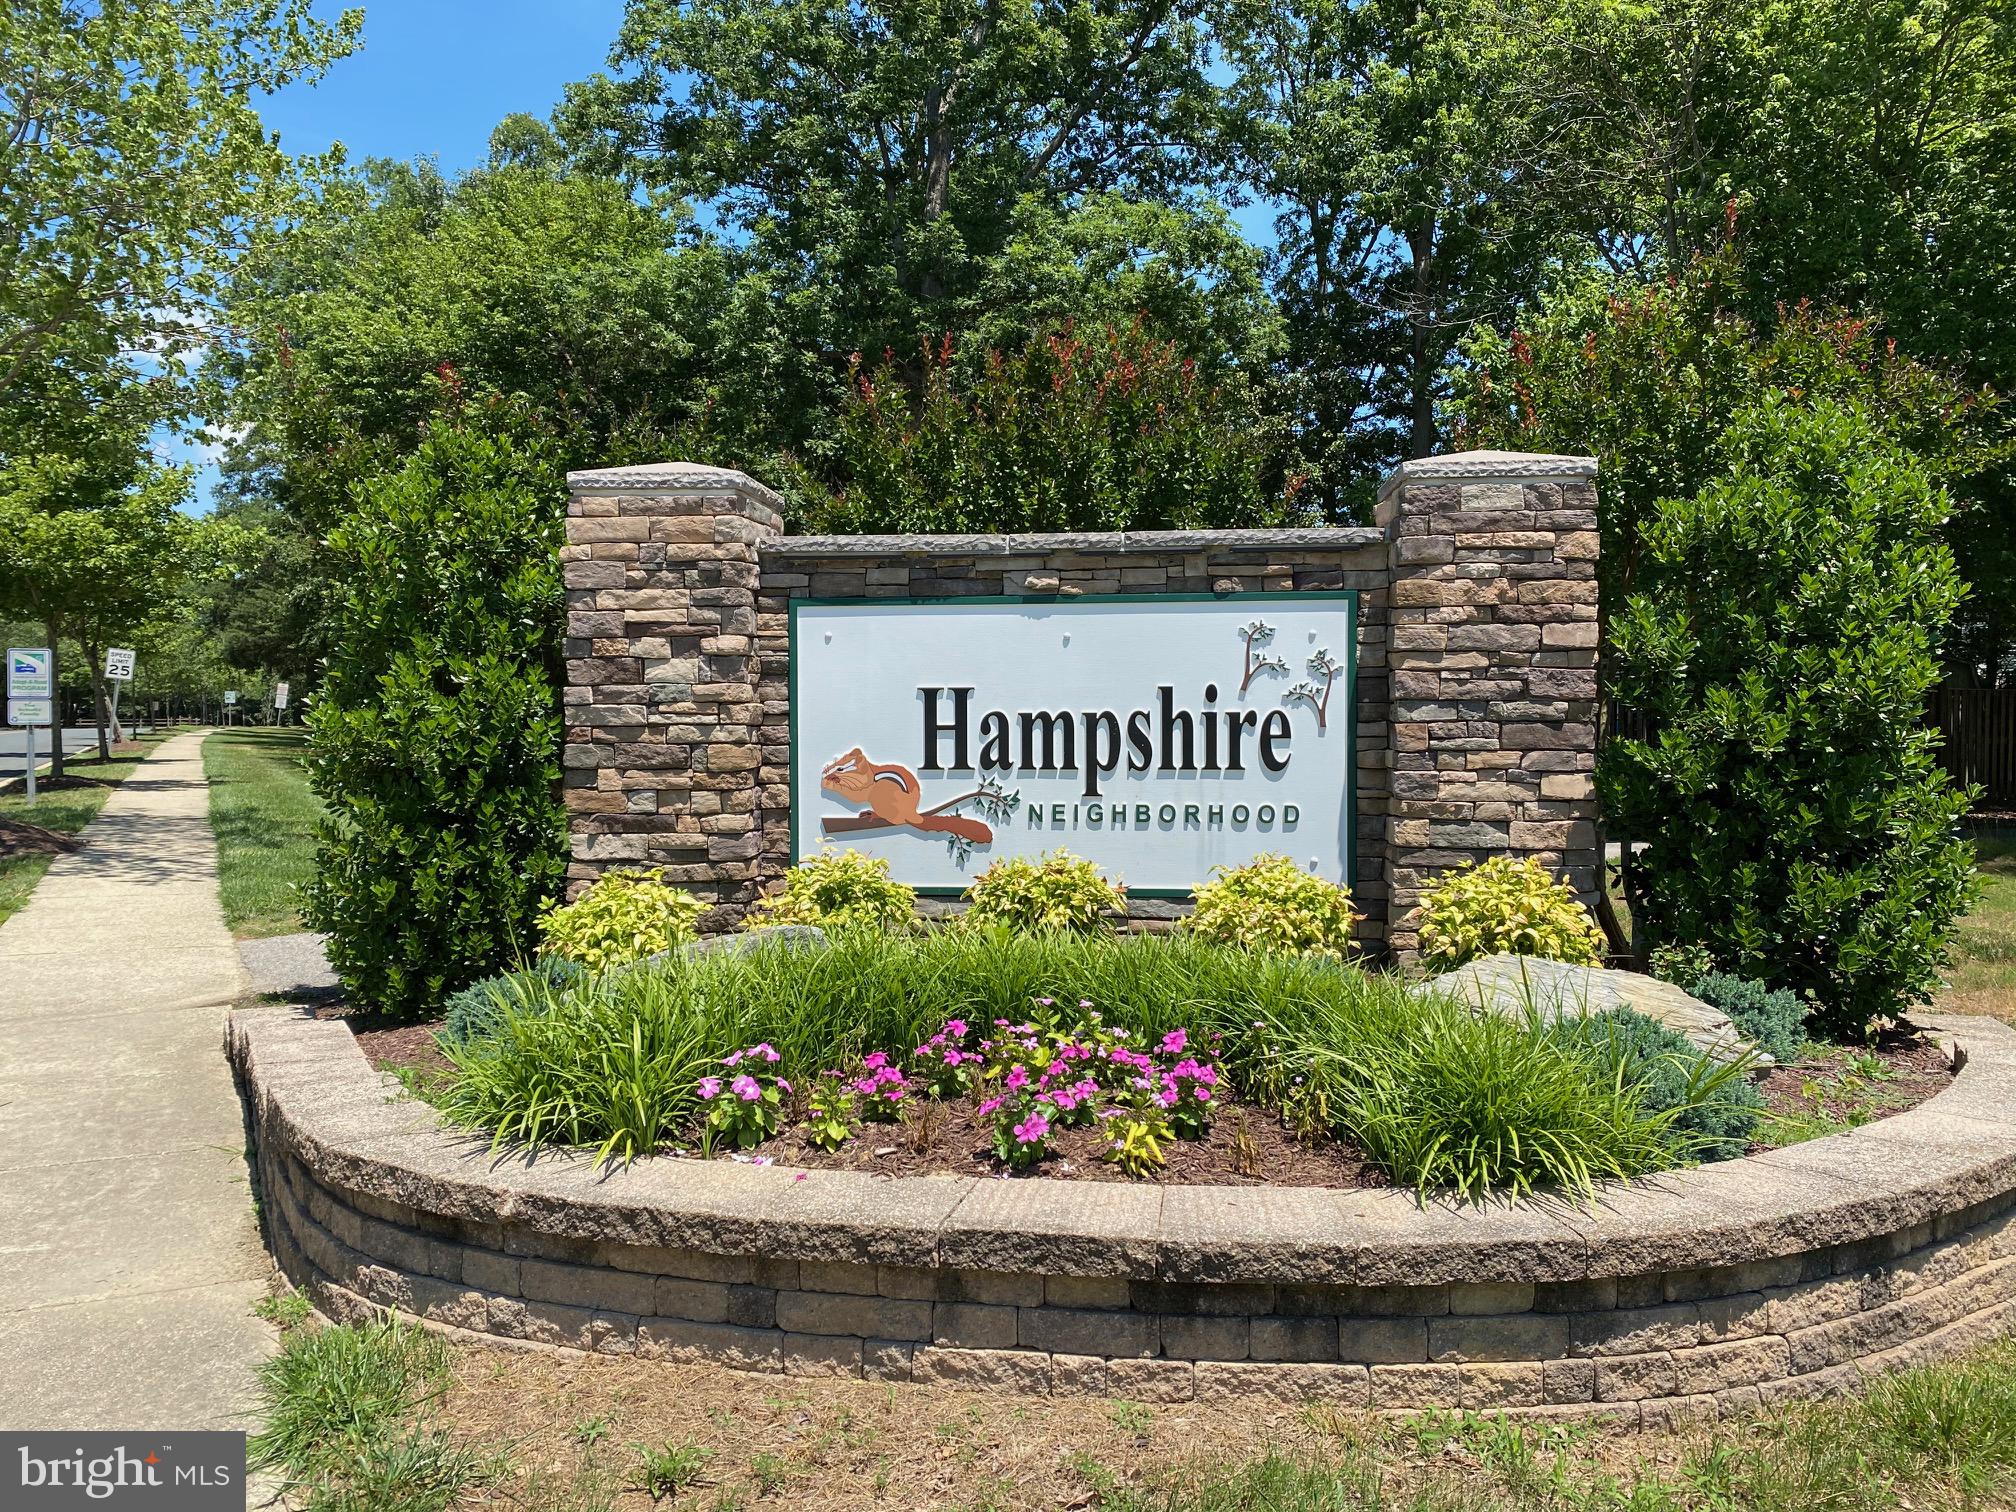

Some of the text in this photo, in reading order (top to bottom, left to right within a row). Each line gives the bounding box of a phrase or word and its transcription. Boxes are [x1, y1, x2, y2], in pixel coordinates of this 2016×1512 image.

[110, 651, 132, 659] SPEED
[108, 664, 130, 676] 25
[917, 684, 1292, 797] Hampshire
[1028, 803, 1300, 825] NEIGHBORHOOD
